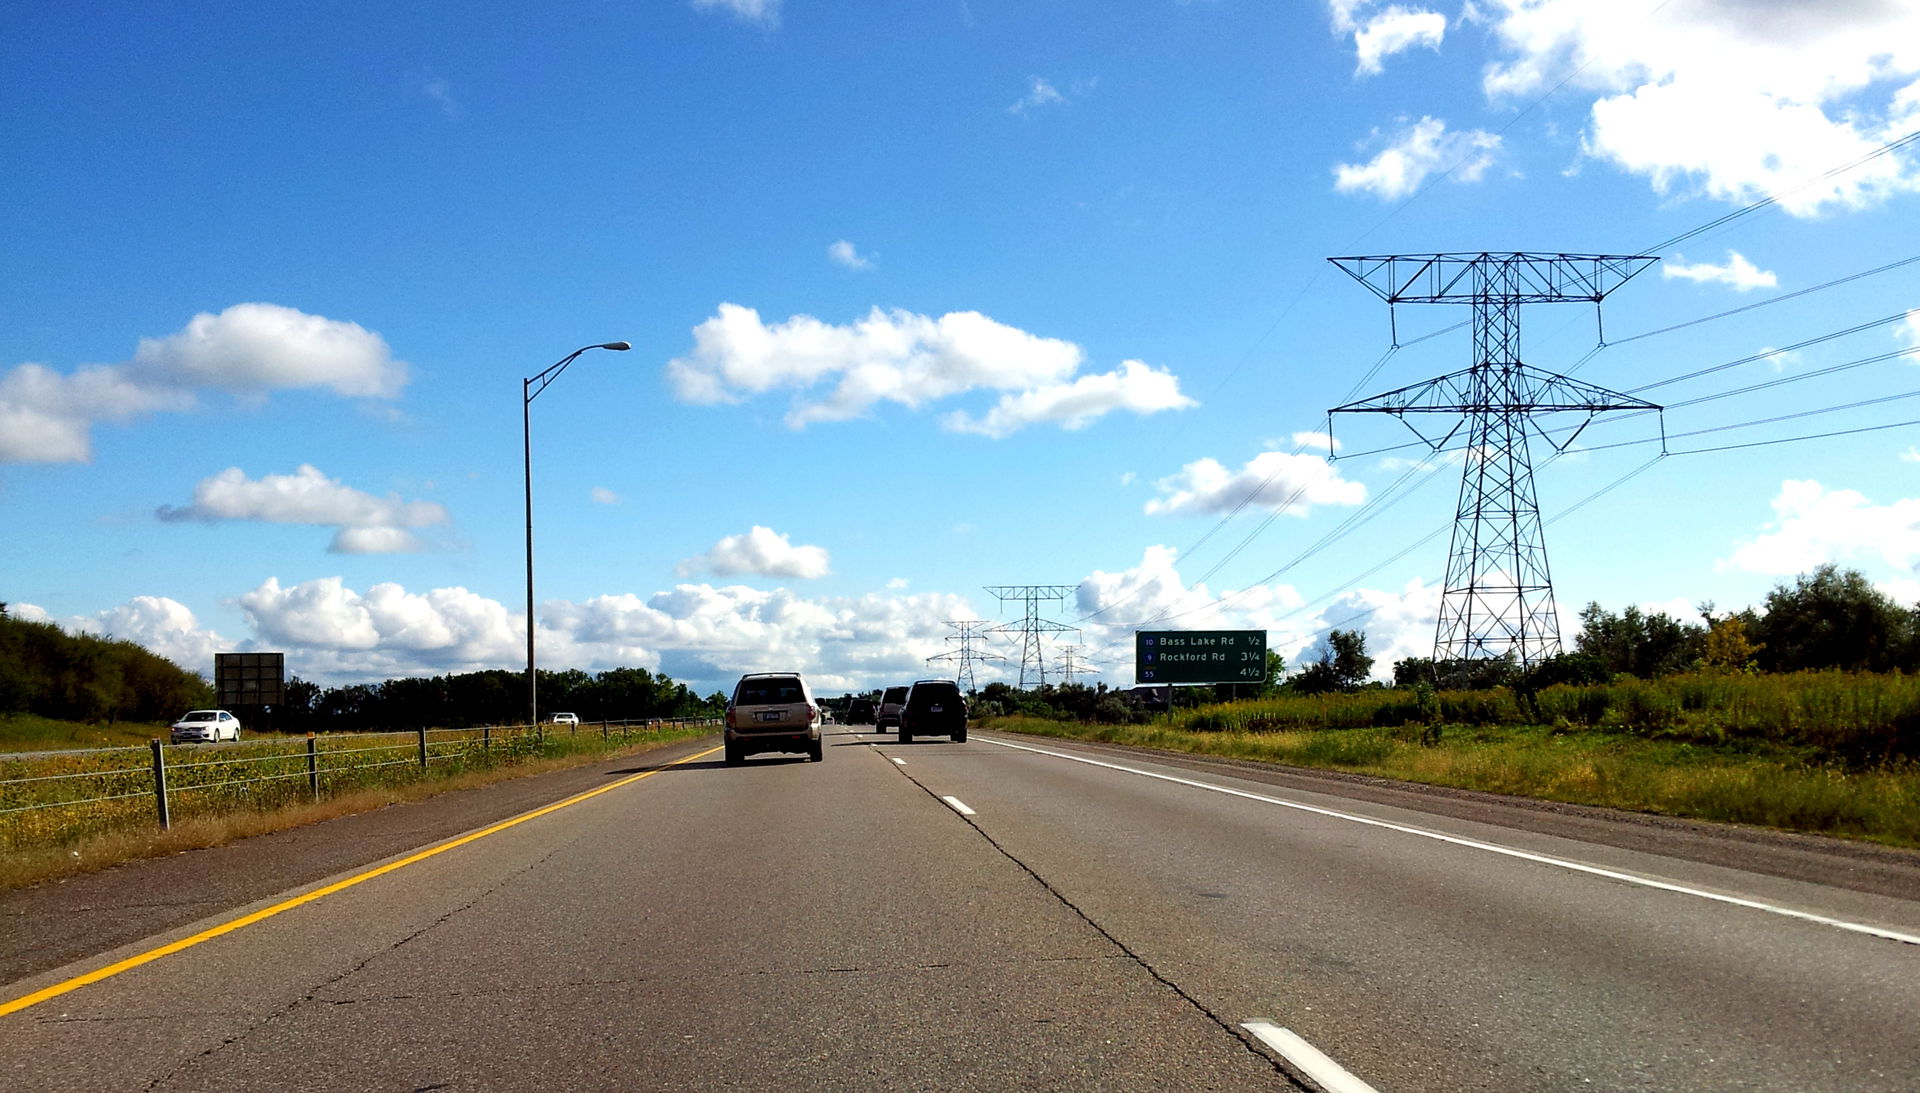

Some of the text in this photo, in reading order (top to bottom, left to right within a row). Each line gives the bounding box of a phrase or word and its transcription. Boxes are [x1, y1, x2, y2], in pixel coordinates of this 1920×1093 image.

[1159, 636, 1234, 646] Bass Lake Rd
[1160, 652, 1225, 661] Rockford Rd
